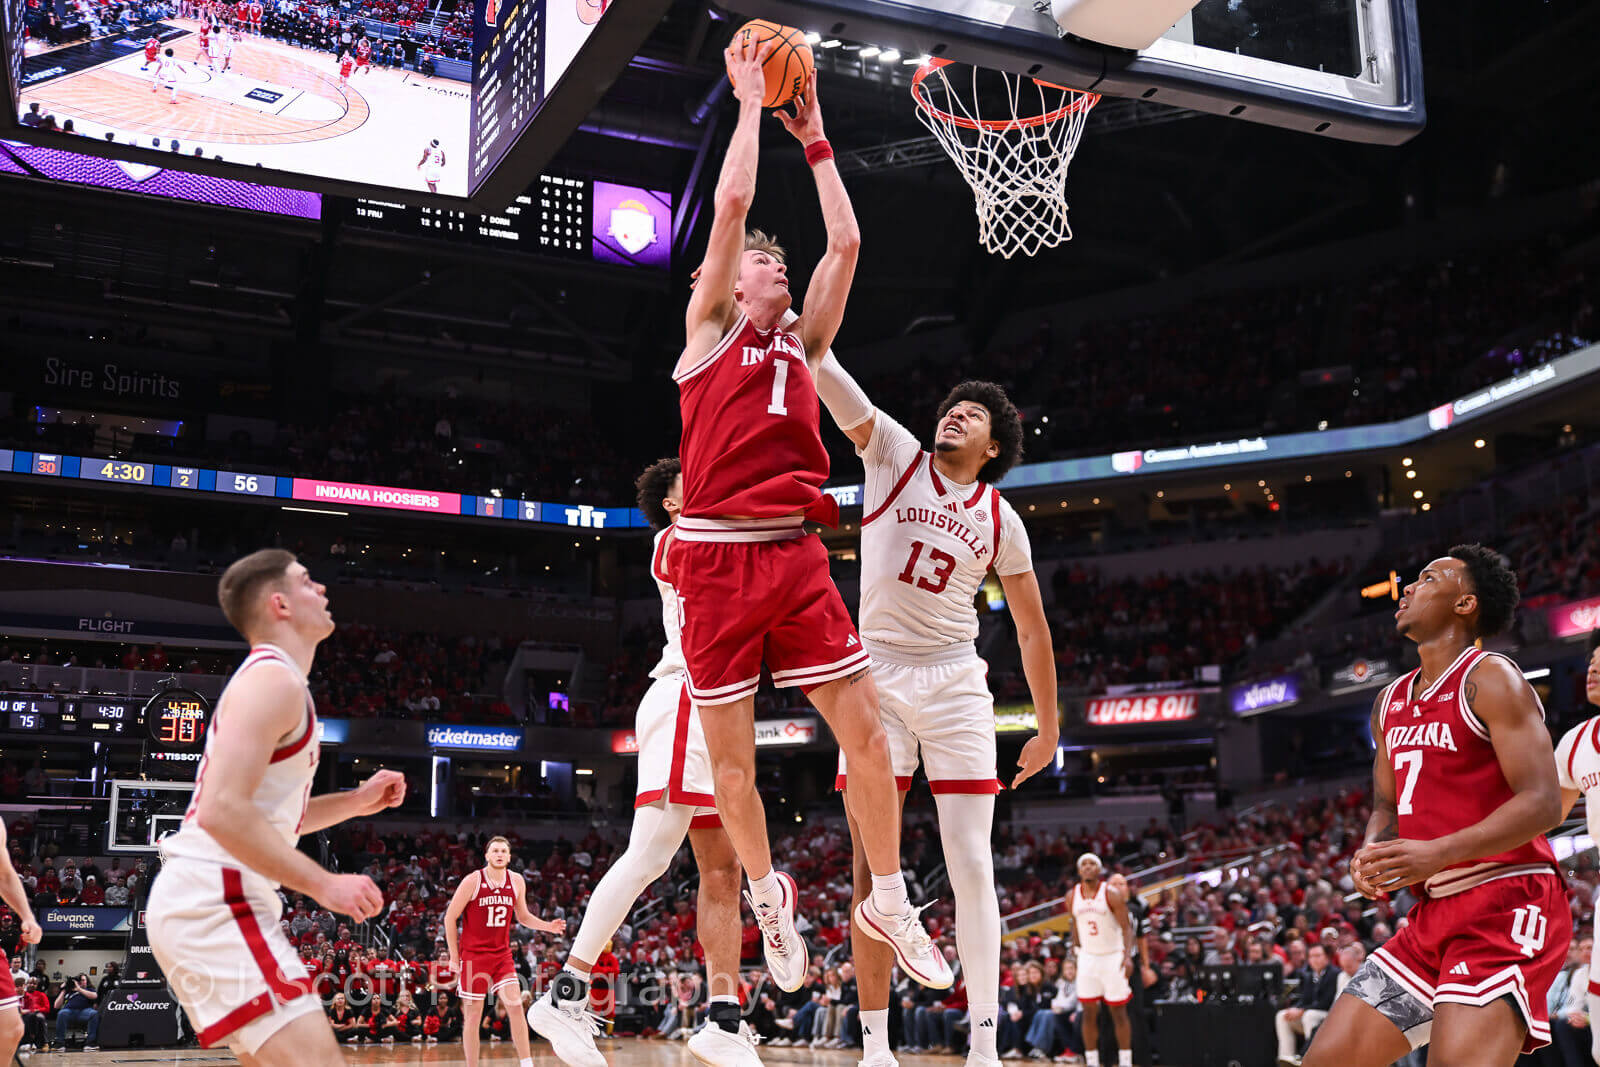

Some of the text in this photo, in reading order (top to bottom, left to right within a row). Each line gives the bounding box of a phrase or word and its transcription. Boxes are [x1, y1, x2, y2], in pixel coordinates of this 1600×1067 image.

[45, 357, 93, 389] Sire
[103, 364, 180, 399] Spirits
[767, 358, 789, 416] 1
[37, 461, 56, 474] 30
[101, 462, 145, 482] 4:30
[180, 475, 189, 487] 2
[234, 475, 258, 492] 56
[315, 484, 440, 508] INDIANA HOOSIERS
[896, 507, 988, 561] LOUISVILLE
[898, 540, 957, 595] 13
[79, 618, 134, 633] FLIGHT
[12, 702, 27, 712] OF
[98, 706, 124, 719] 4:30
[1087, 694, 1197, 723] LUCAS OIL
[19, 715, 34, 728] 75
[427, 727, 521, 747] ticketmaster
[1385, 721, 1458, 760] NDIANA
[164, 752, 202, 761] TISSOT
[1394, 749, 1424, 816] 7
[479, 895, 514, 907] INDIANA
[47, 912, 96, 923] Elevance
[486, 906, 507, 928] 12
[69, 921, 95, 930] Health
[1088, 921, 1099, 937] 3
[107, 1000, 170, 1012] CareSource
